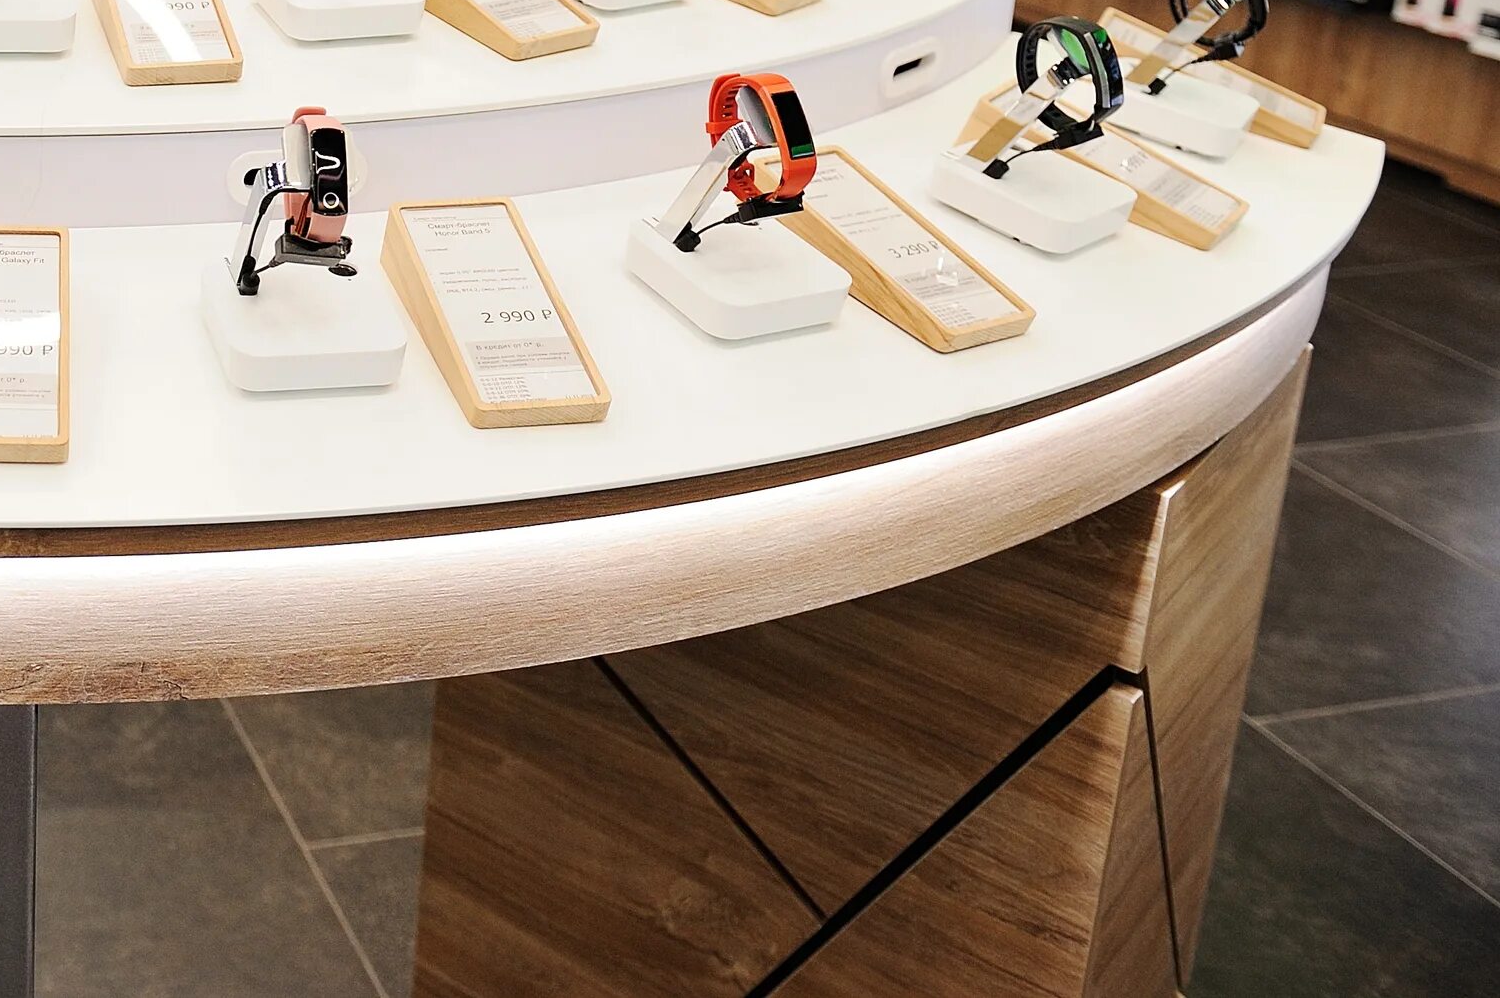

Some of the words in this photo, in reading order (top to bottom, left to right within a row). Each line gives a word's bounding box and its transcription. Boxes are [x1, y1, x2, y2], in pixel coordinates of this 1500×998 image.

[888, 248, 902, 259] 3
[901, 242, 930, 257] 290
[481, 312, 494, 323] 2
[500, 309, 535, 322] 990
